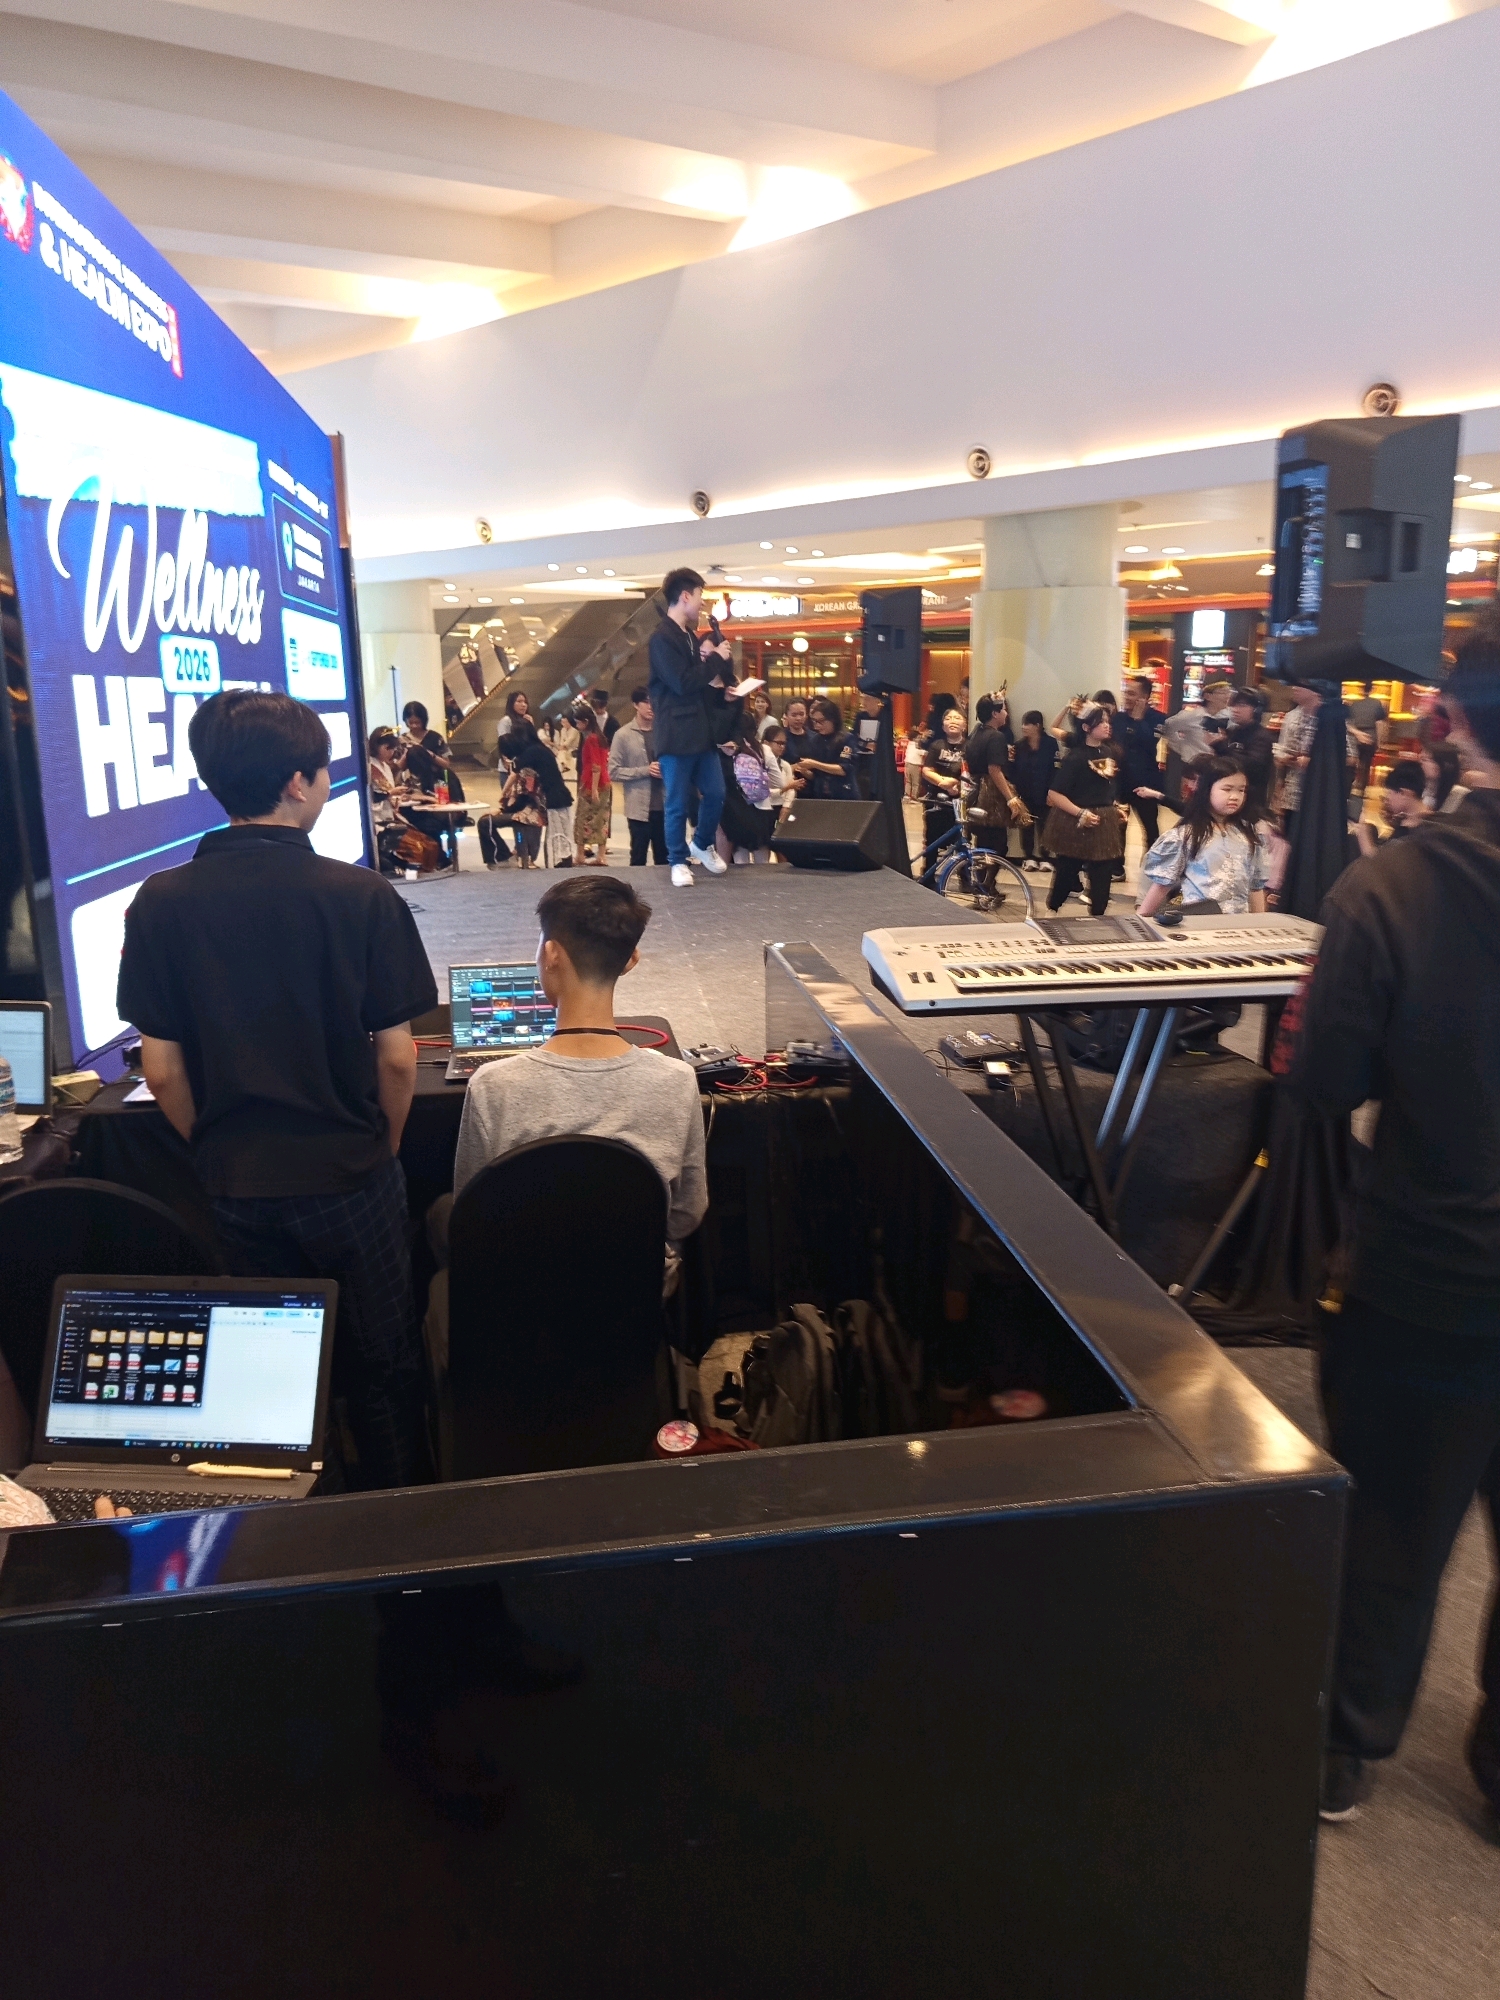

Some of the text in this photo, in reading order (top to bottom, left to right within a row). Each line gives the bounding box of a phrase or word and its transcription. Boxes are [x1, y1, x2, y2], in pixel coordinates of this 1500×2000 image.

[39, 222, 62, 275] &
[59, 237, 132, 331] HEALTH
[47, 474, 265, 654] Wellness
[814, 601, 845, 613] KOREAN
[173, 645, 211, 682] 2026
[72, 673, 272, 818] HEA
